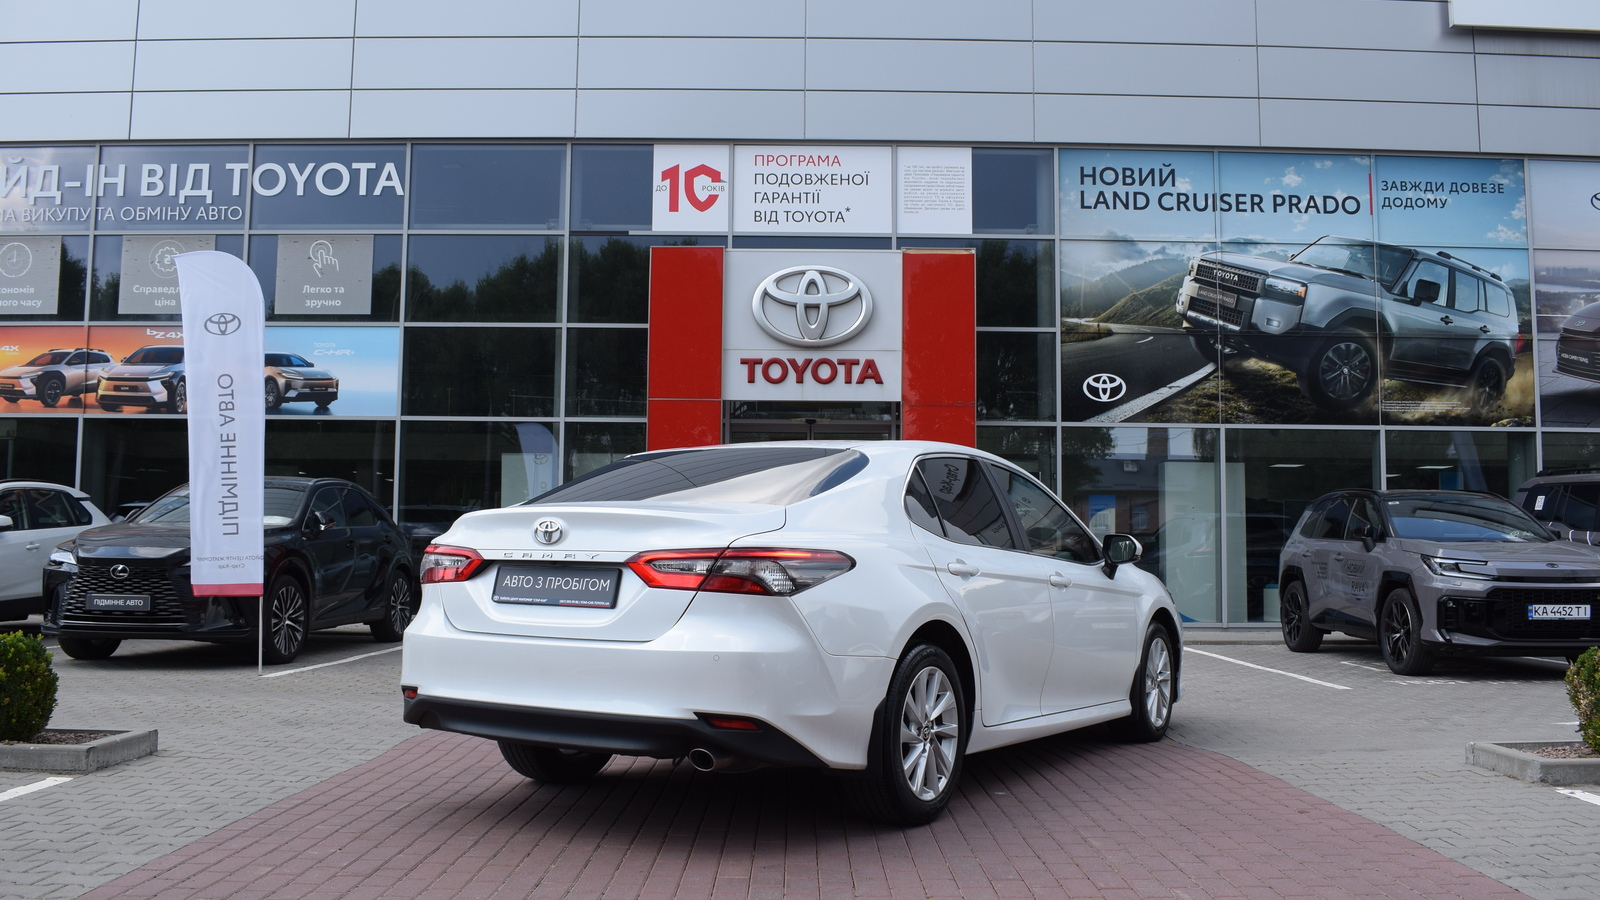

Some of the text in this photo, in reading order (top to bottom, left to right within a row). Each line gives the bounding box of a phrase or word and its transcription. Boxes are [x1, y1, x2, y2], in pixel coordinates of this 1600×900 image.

[754, 154, 841, 167] ПРОГРАМА
[754, 171, 869, 187] ПОДОВЖЕНОЇ
[1079, 163, 1176, 188] НОВИЙ
[140, 163, 213, 204] ВІД
[225, 162, 405, 197] TOYOTA
[655, 184, 667, 193] ДО
[1381, 180, 1505, 196] ЗАВЖДИ ДОВЕЗЕ
[754, 190, 821, 204] ГАРАНТІЇ
[1079, 190, 1361, 215] LAND CRUISER PRADO
[1381, 197, 1447, 210] ДОДОМУ
[21, 207, 90, 222] ВИКУПУ
[97, 207, 115, 221] ТА
[120, 206, 191, 221] ОБМІНУ
[195, 205, 243, 221] АВТО
[754, 210, 779, 225] ВІД
[0, 285, 35, 294] ономія
[302, 285, 344, 295] Легко та
[0, 299, 42, 308] ого часу
[154, 298, 176, 307] ціна
[305, 298, 342, 309] зручно
[740, 358, 884, 385] TOYOTA
[503, 551, 600, 560] CAMRY
[502, 575, 611, 592] АВТО З ПРОБІГОМ
[93, 598, 125, 607] ПІДМІННЕ
[1534, 606, 1548, 616] KA
[1550, 606, 1573, 616] 4452
